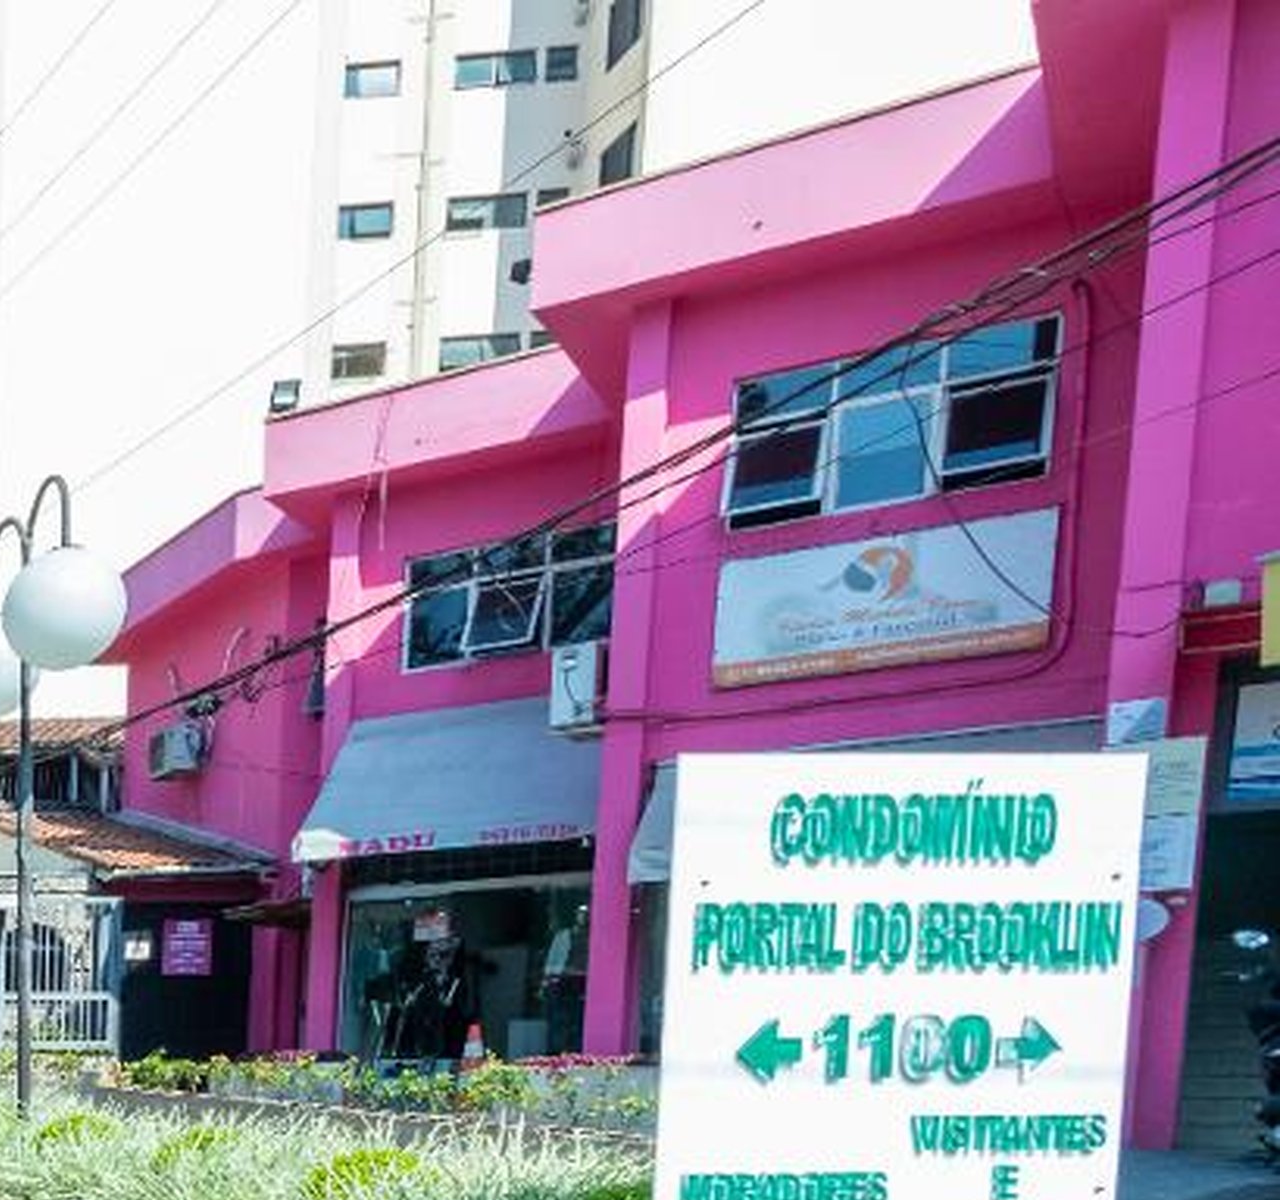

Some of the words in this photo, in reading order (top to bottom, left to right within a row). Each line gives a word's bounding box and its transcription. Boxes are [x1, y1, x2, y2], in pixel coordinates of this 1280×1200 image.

[770, 779, 1058, 866] CONDOMÍNIO
[692, 902, 844, 973] PORTAL
[851, 902, 912, 973] DO
[916, 901, 1122, 974] BROOKLIN
[813, 1014, 992, 1084] 1100
[910, 1114, 1107, 1156] VISITANTES
